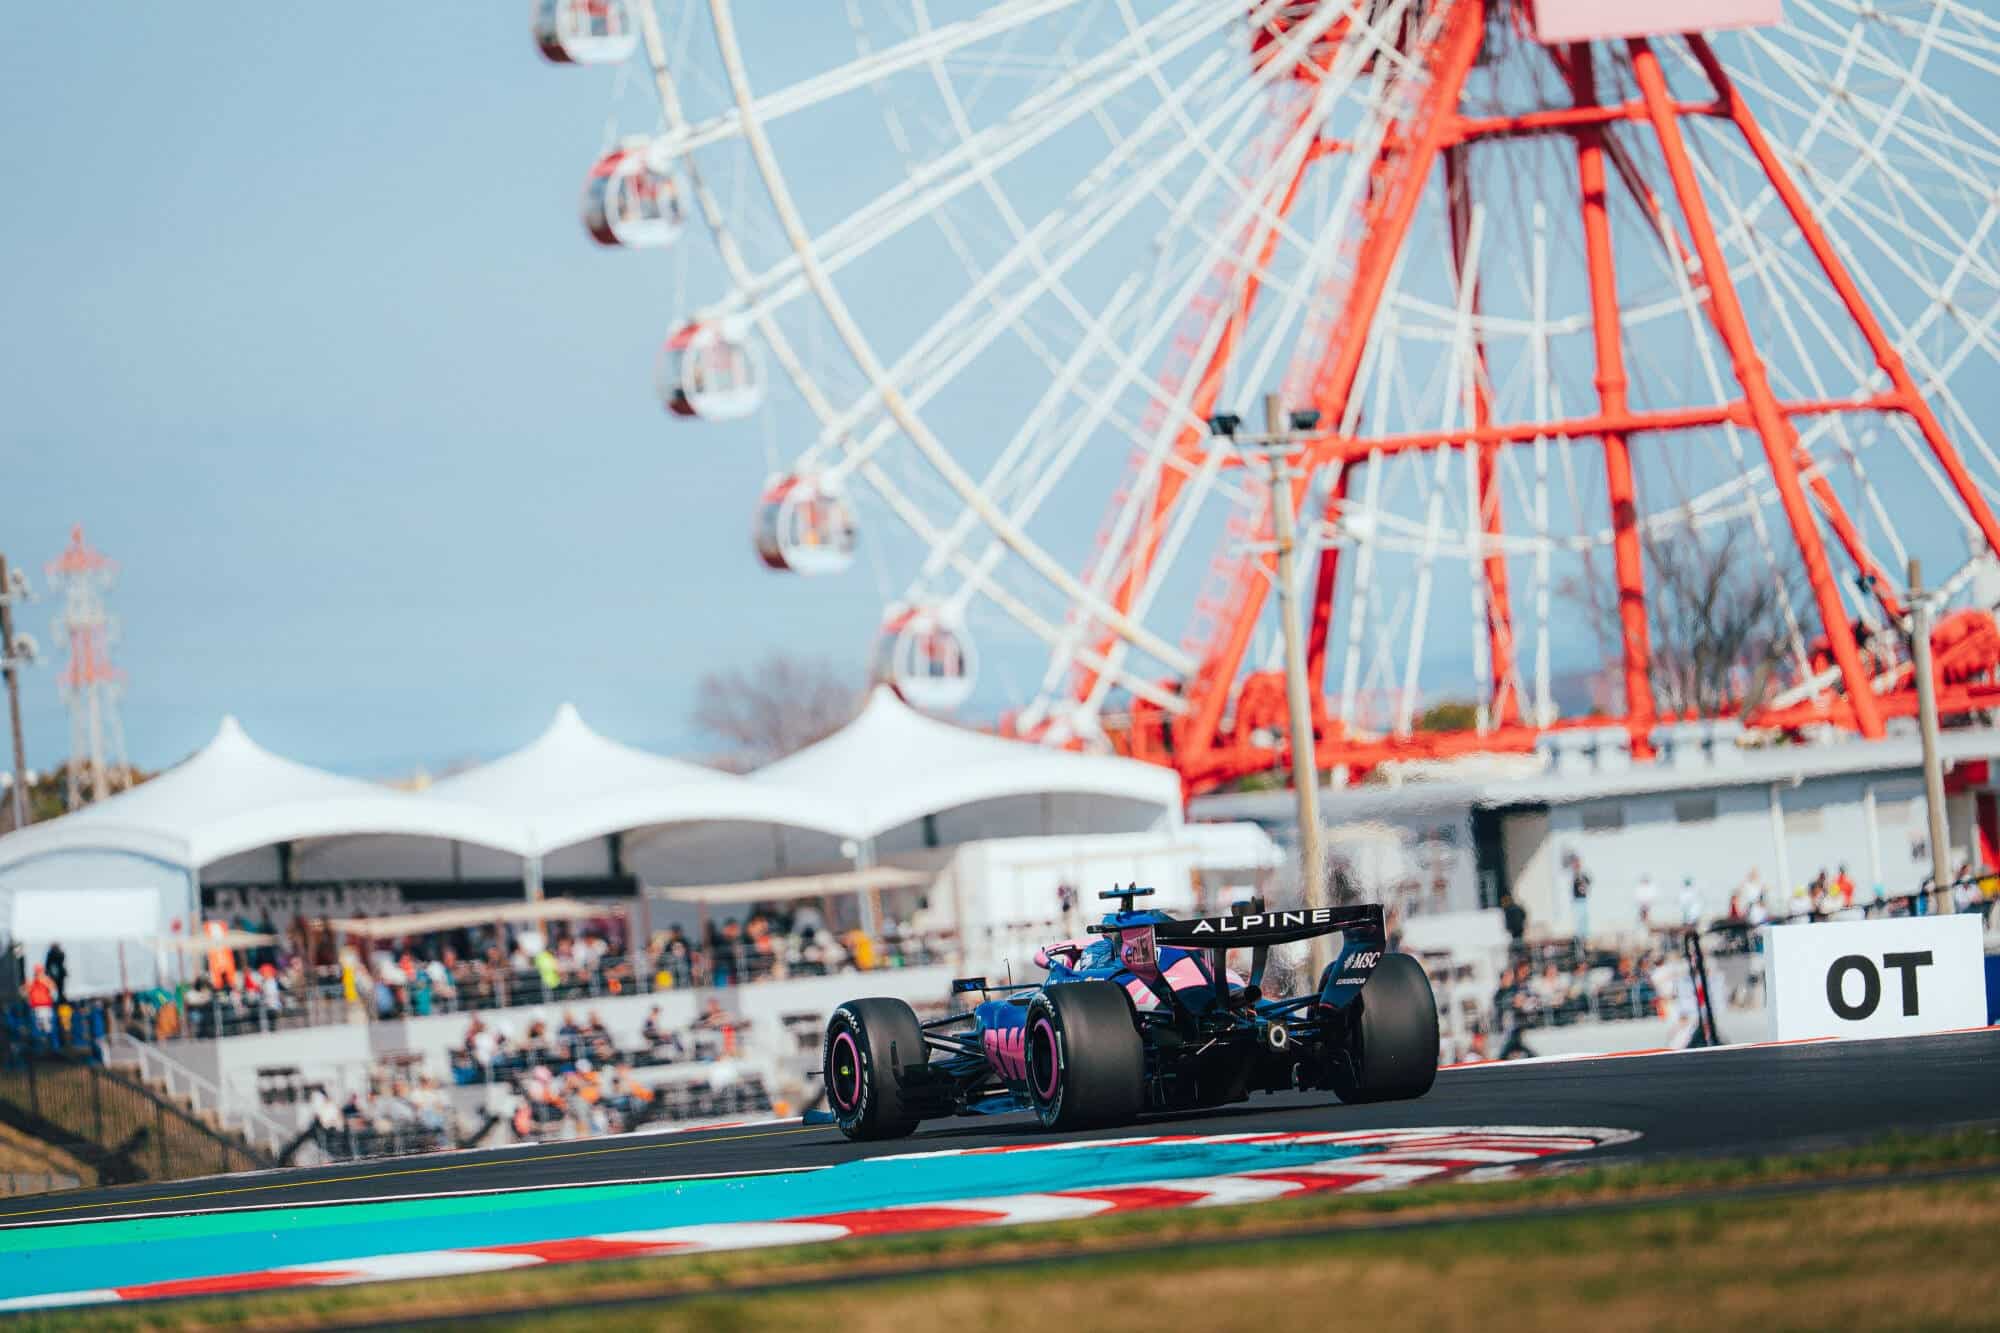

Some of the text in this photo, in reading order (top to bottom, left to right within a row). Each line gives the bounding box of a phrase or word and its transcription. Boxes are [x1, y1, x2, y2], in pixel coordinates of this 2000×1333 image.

[1192, 909, 1331, 934] ALPINE
[1351, 951, 1381, 969] MSC
[1826, 950, 1933, 1021] OT
